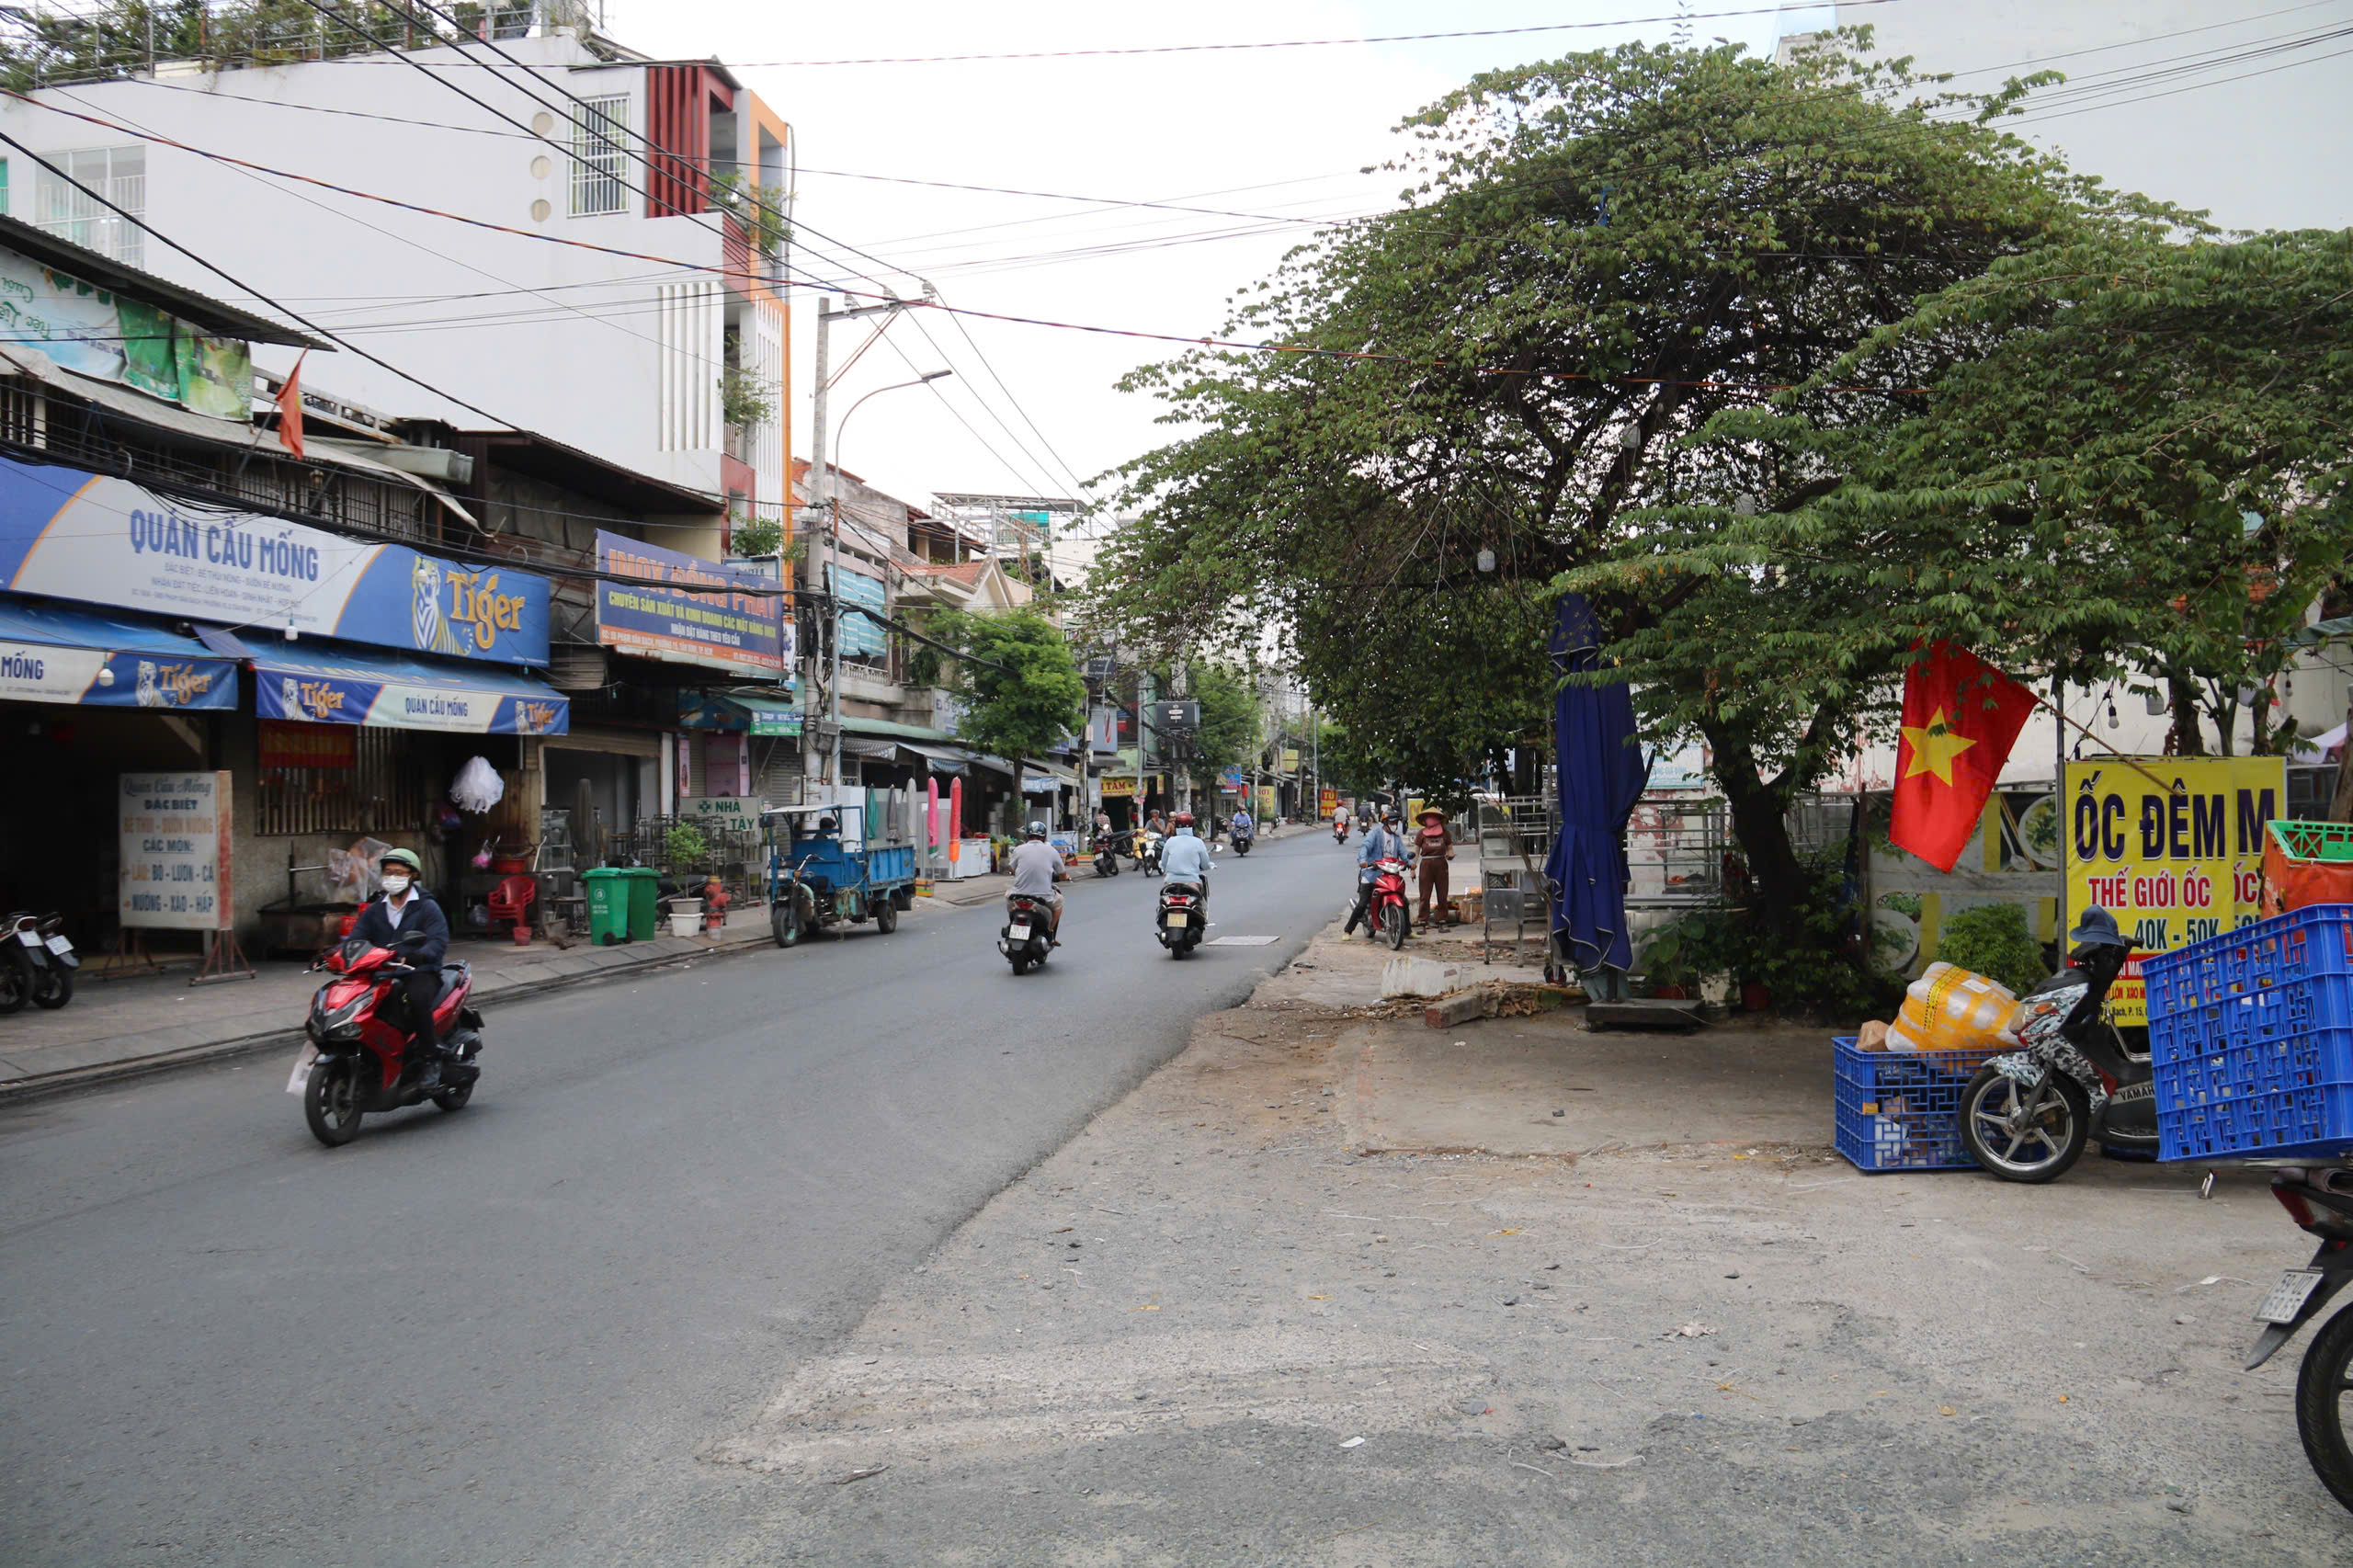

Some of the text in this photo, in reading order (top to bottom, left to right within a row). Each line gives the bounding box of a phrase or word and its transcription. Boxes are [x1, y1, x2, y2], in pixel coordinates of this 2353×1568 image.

[130, 508, 199, 560] QUÁN
[259, 528, 319, 582] MỐNG
[608, 548, 666, 595] INOX
[445, 570, 526, 651] Tiger
[1, 651, 44, 681] MỐNG
[159, 663, 213, 704] Tiger
[300, 680, 346, 719] Tiger
[404, 695, 427, 715] QUÁN
[144, 797, 199, 811] ĐẶC BIỆT
[715, 798, 741, 812] NHÀ
[2075, 770, 2226, 862] ỐC ĐÊM
[730, 815, 755, 831] TÂY
[2088, 866, 2211, 908] THẾ GIỚI ỐC
[2136, 918, 2167, 950] 40K
[2120, 1085, 2155, 1101] YAMAH
